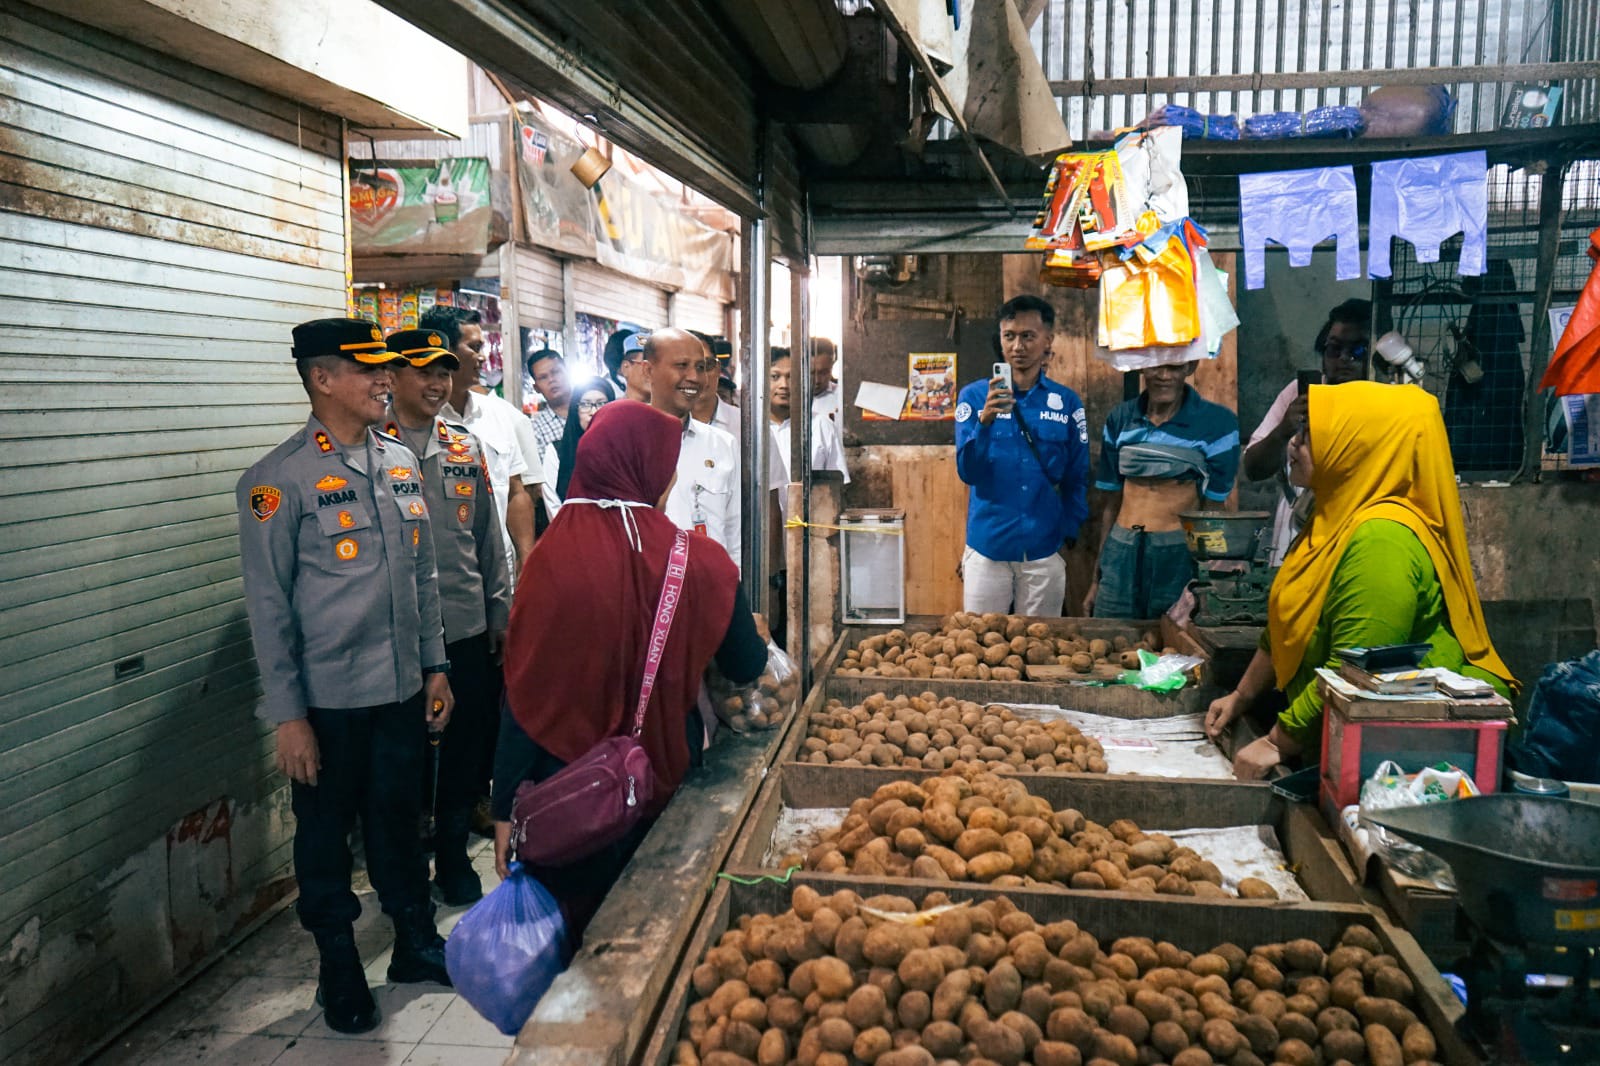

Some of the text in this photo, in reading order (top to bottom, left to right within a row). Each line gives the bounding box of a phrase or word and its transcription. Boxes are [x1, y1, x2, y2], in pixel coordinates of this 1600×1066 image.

[1040, 411, 1069, 424] HUMAS
[443, 466, 478, 478] POLRI
[392, 483, 420, 495] POLRI
[318, 490, 357, 507] AKBAR
[669, 565, 684, 577] H
[659, 584, 678, 624] HONG
[649, 627, 666, 663] XUAN
